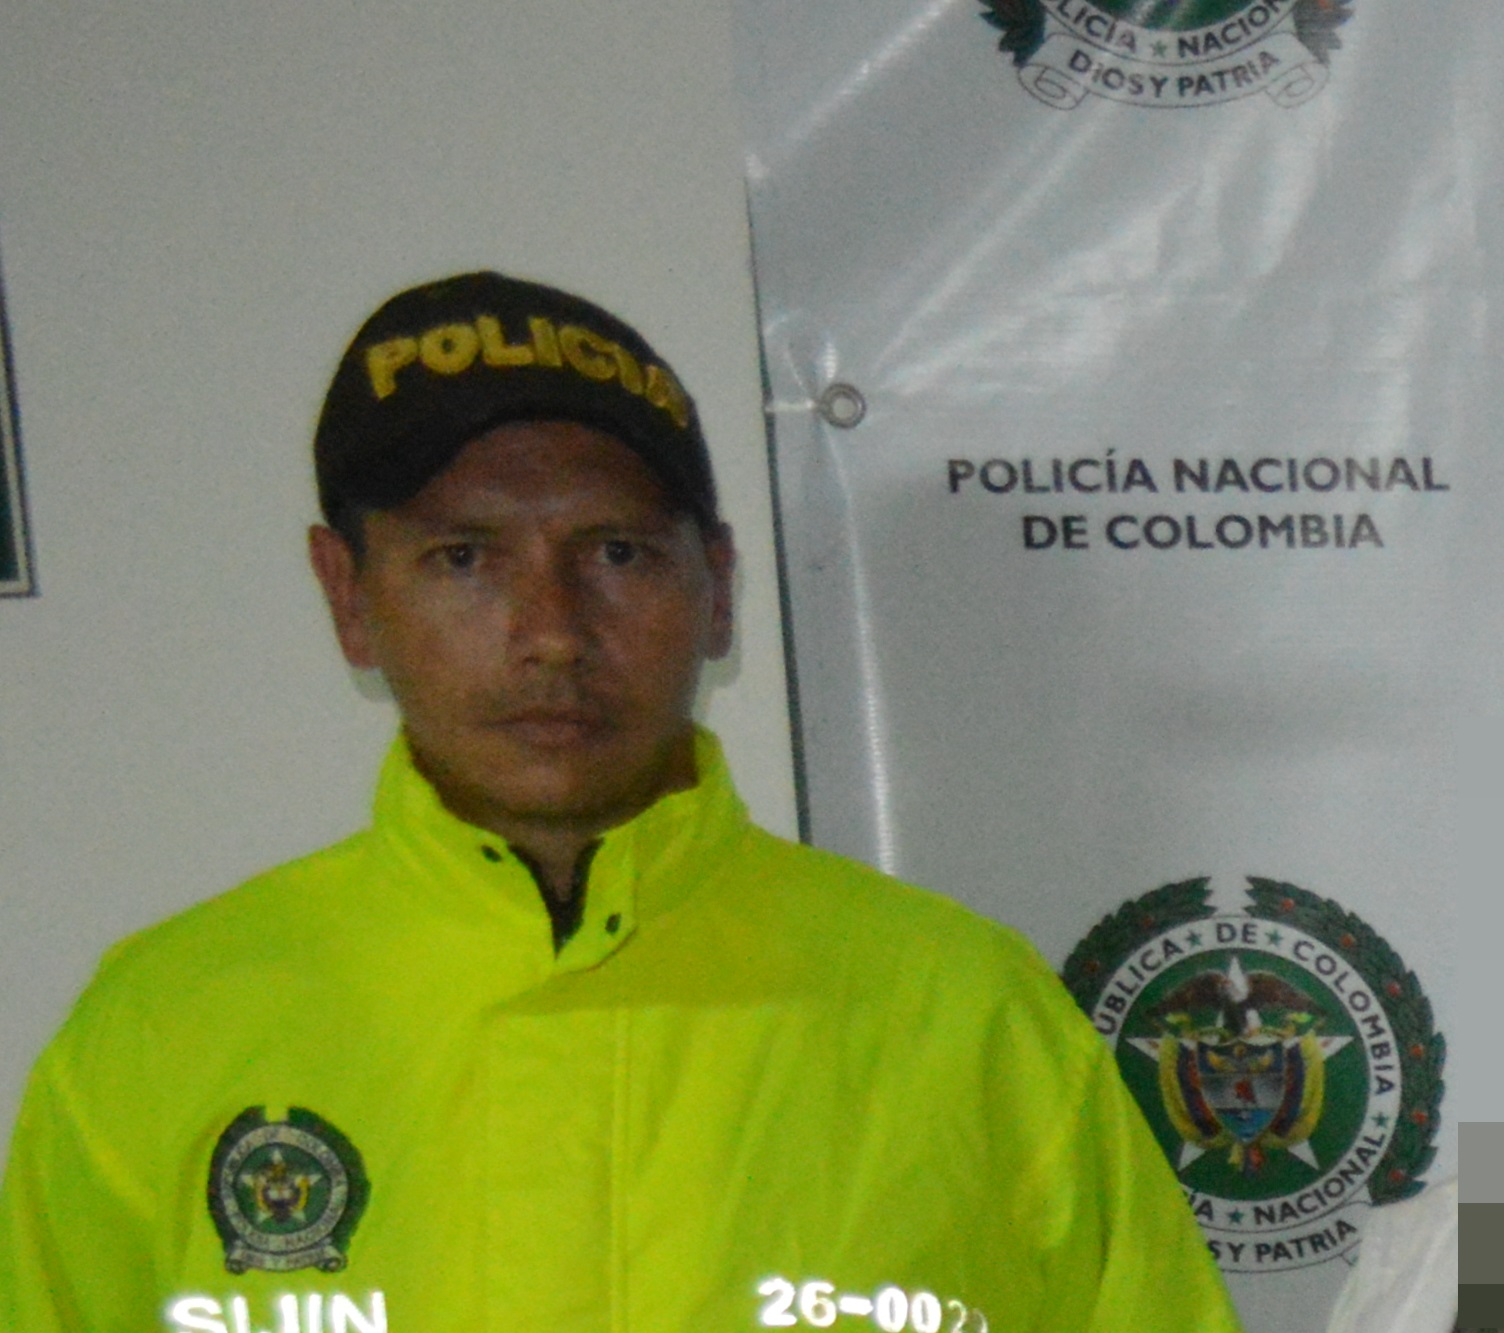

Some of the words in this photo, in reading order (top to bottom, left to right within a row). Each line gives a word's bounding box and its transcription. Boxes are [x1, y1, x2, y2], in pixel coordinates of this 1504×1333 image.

[1177, 50, 1280, 97] PATRIA
[946, 449, 1159, 497] POLICÍA
[1173, 456, 1451, 495] NACIONAL
[1021, 513, 1090, 552] DE
[1103, 512, 1386, 552] COLOMBIA
[1215, 922, 1258, 944] DE
[1293, 940, 1396, 1096] COLOMBIA
[1253, 1132, 1388, 1226] NACIONAL
[1255, 1218, 1358, 1263] PATRIA
